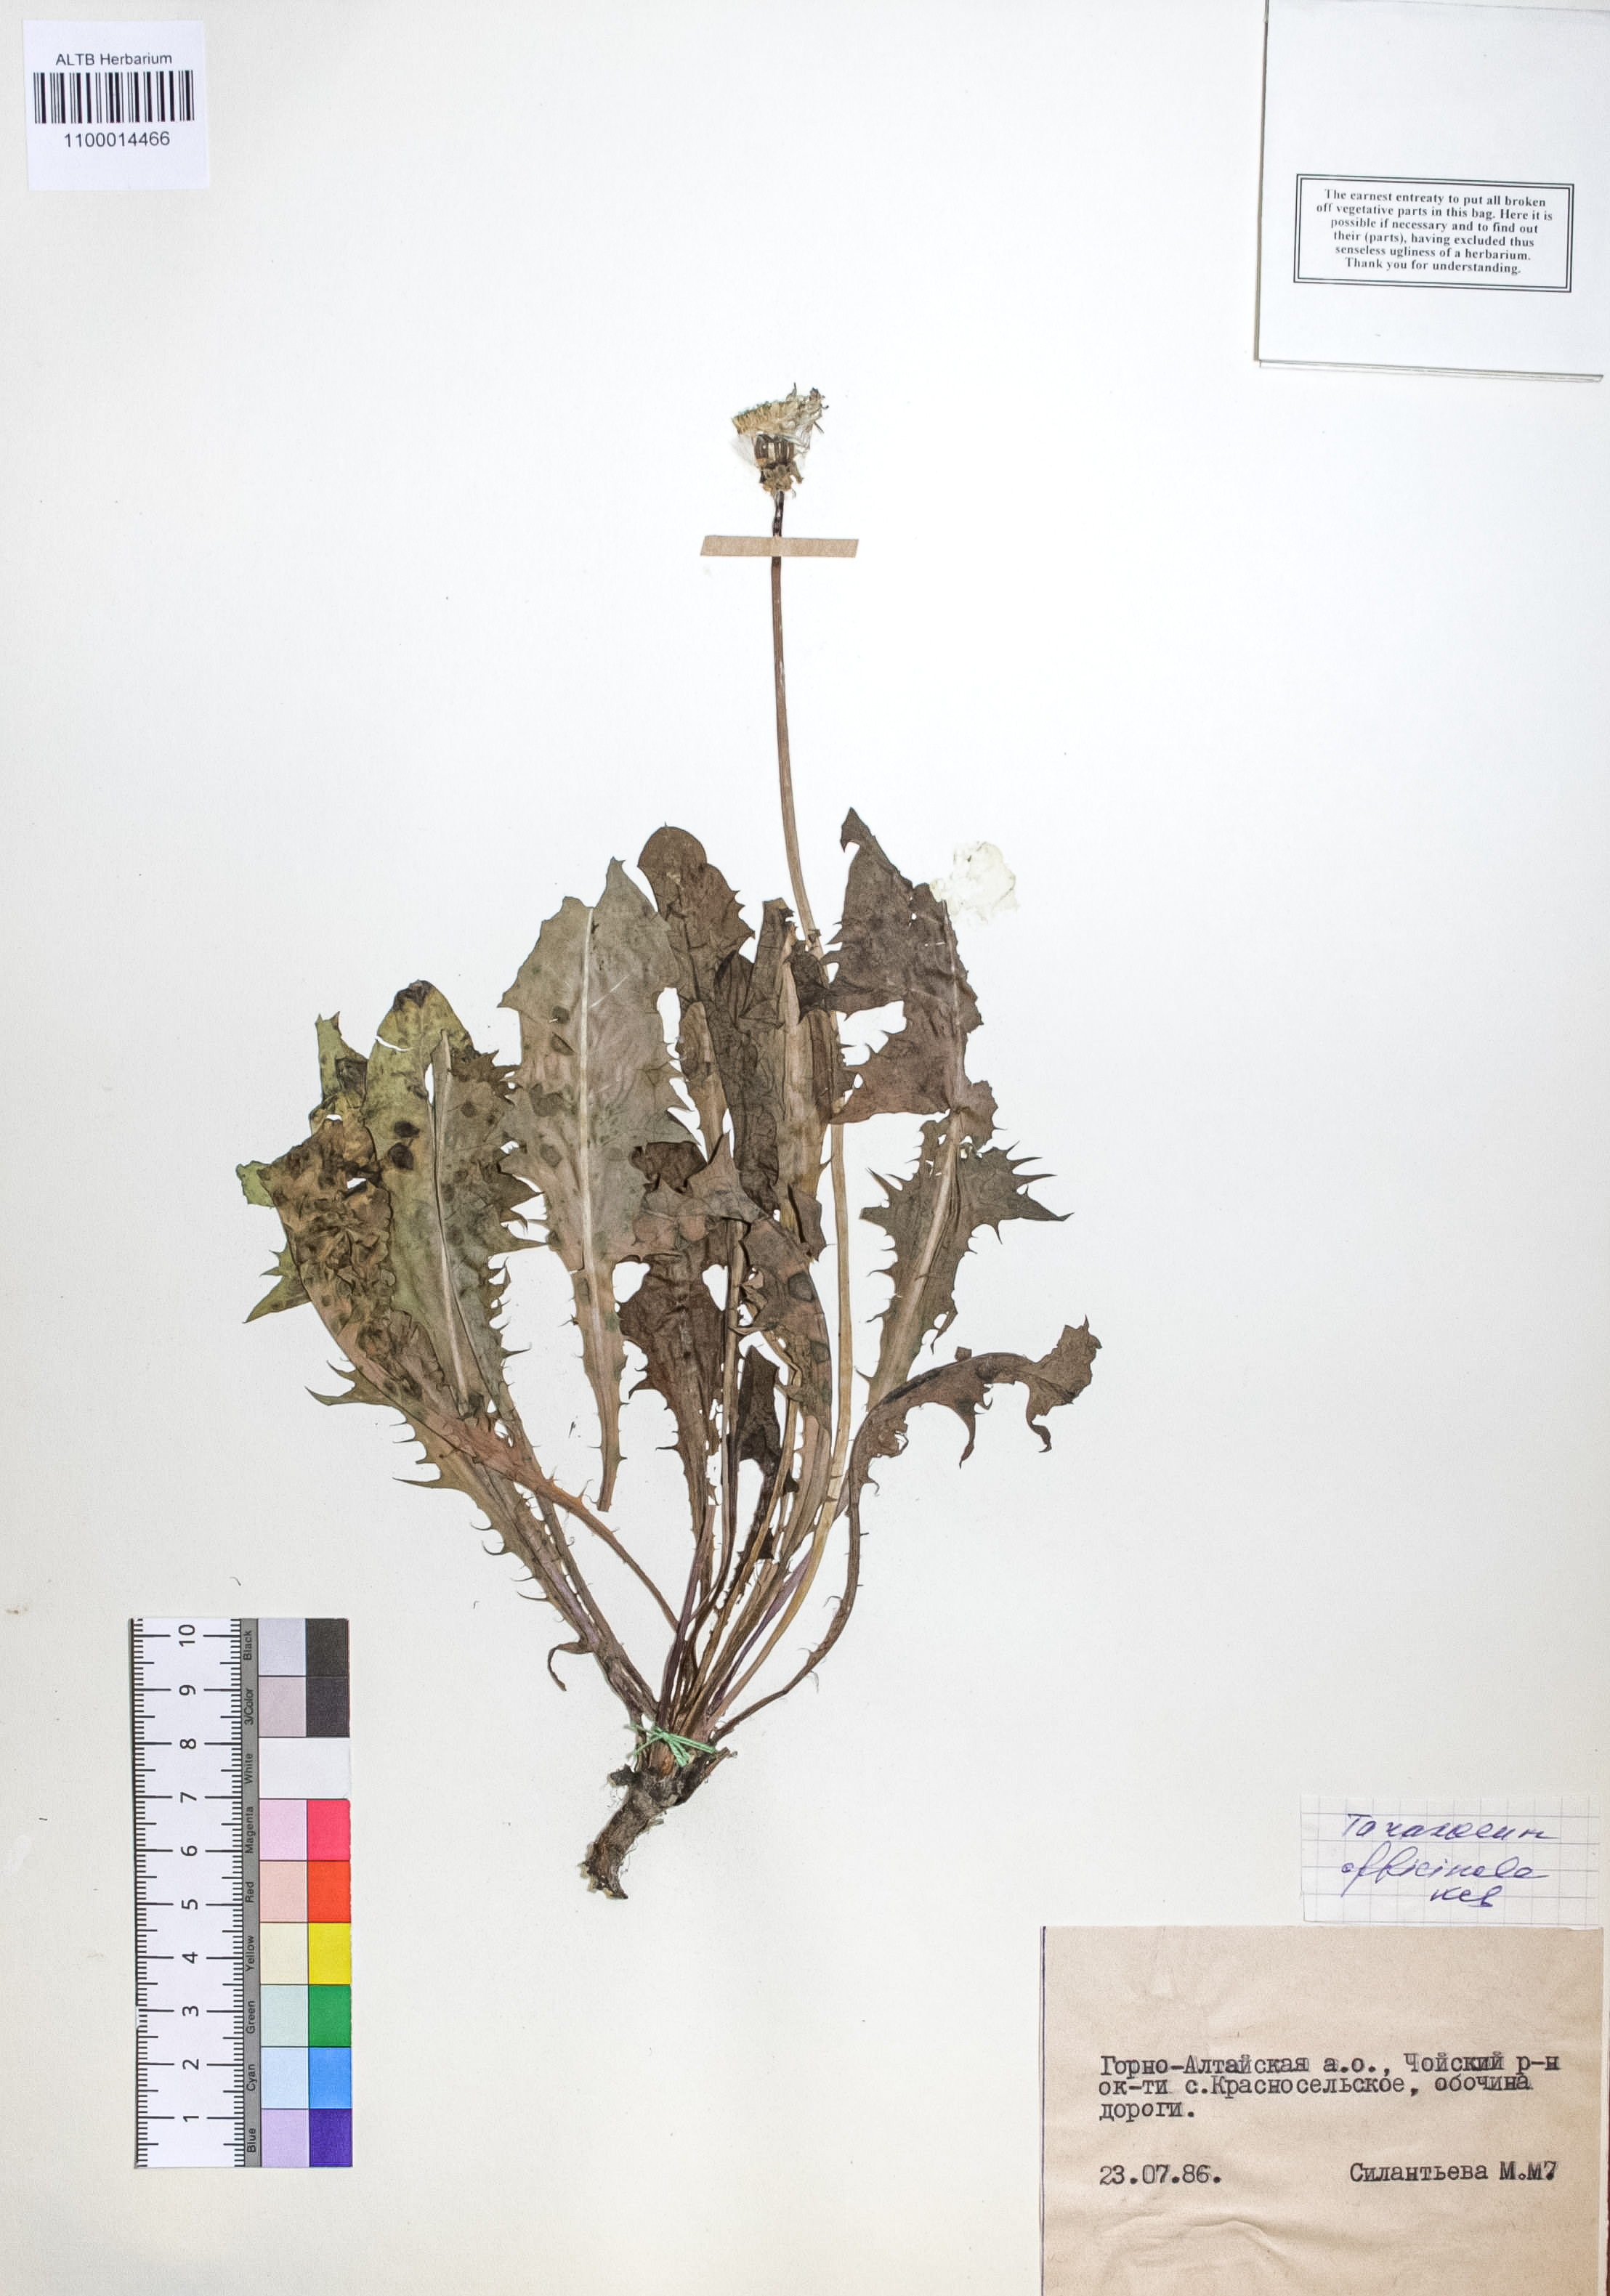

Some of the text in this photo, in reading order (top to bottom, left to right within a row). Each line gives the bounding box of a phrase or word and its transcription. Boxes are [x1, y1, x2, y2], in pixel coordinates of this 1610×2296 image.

[56, 52, 172, 65] ALTB Herbarium
[65, 131, 170, 147] 1100014466
[1325, 189, 1346, 199] The
[1396, 194, 1444, 205] entreaty
[1464, 197, 1482, 206] put
[1486, 195, 1500, 205] all
[1505, 196, 1545, 206] broken
[1316, 203, 1552, 221] off vegetative parts in this bag. Here it is
[1331, 218, 1376, 228] possible
[1380, 219, 1389, 228] if
[1393, 222, 1447, 232] necessary
[1452, 221, 1473, 231] and
[1493, 222, 1515, 232] find
[1334, 230, 1534, 246] their (parts), having excluded thus
[1336, 246, 1386, 255] senseless
[1391, 246, 1435, 257] ugliness
[1439, 248, 1452, 257] of
[1465, 248, 1530, 260] herbarium.
[1346, 257, 1521, 275] Thank you for understanding.
[178, 1624, 195, 1647] 10
[243, 1630, 253, 1660] Black
[179, 1685, 195, 1695] 9
[244, 1688, 254, 1725] 3/Color
[179, 1738, 196, 1749] 8
[244, 1753, 254, 1784] White
[180, 1792, 197, 1804] 7
[244, 1806, 256, 1854] Magenta
[181, 1846, 198, 1856] 6
[244, 1881, 255, 1903] Red
[182, 1899, 198, 1910] 5
[182, 1952, 198, 1964] 4
[246, 1935, 255, 1971] Yellow
[182, 2006, 198, 2016] 3
[246, 2000, 256, 2034] Green
[182, 2059, 199, 2070] 2
[1101, 2051, 1561, 2077] Горно-Алтайская а.о., Чойский р-н
[246, 2064, 256, 2091] Cyan
[1099, 2079, 1170, 2096] ок-ти
[1435, 2072, 1534, 2092] обочина
[1099, 2101, 1194, 2122] дороги.
[246, 2127, 256, 2152] Blue
[1100, 2164, 1222, 2186] 23.07.86.
[1350, 2162, 1489, 2182] Силантьева
